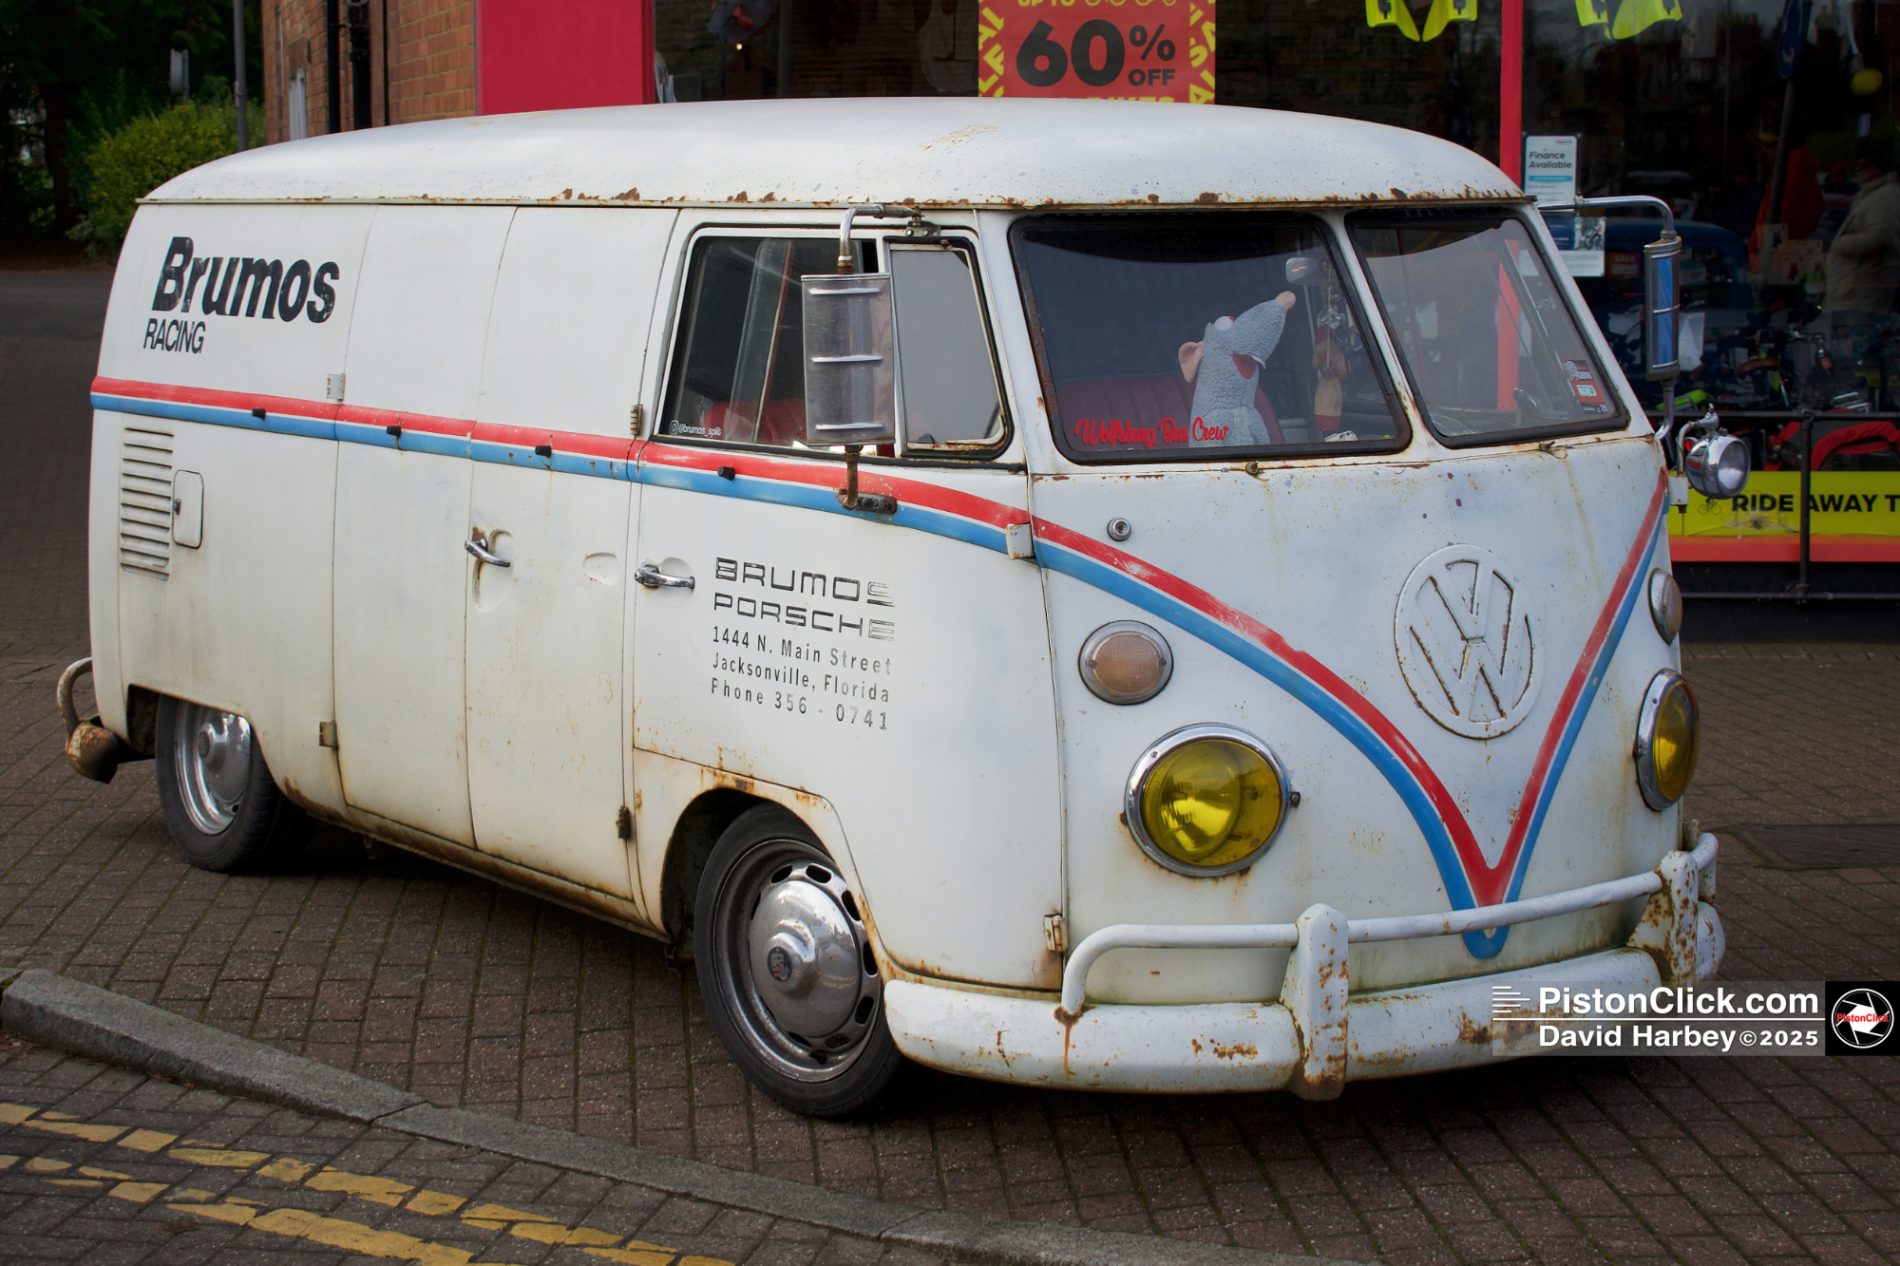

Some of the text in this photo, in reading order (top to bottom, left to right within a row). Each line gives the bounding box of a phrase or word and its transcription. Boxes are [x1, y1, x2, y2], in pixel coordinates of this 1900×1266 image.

[1128, 68, 1176, 87] OFF
[1529, 151, 1566, 160] Finance
[1529, 161, 1572, 169] Available
[152, 236, 340, 324] Brumos
[143, 318, 206, 354] RACING
[1157, 416, 1190, 443] Bus
[1192, 416, 1230, 442] Crew
[1732, 494, 1794, 512] RIDE
[1807, 494, 1878, 512] AWAY
[715, 557, 895, 608] BRUMOS
[714, 592, 895, 642] PORSCHE
[713, 626, 891, 676] 1444 N. Main Street
[712, 652, 889, 703] Jacksonville, Florida
[836, 703, 887, 730] 0741
